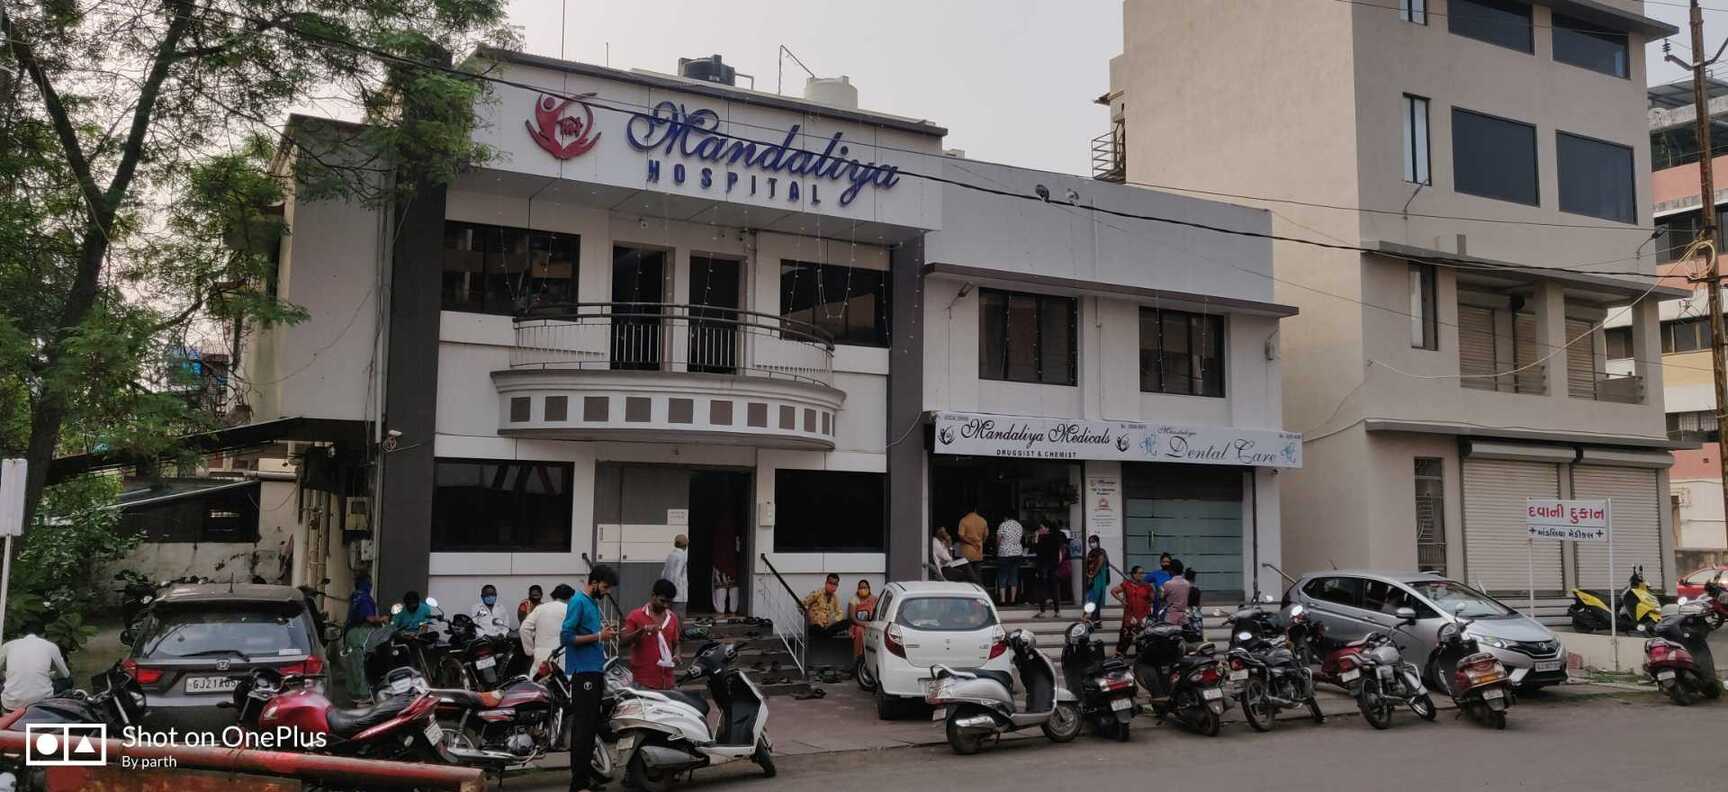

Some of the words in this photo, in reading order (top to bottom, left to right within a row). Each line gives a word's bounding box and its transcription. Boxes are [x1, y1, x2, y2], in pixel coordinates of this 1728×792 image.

[626, 100, 900, 207] Mandaliya
[648, 159, 821, 205] HOSPITAL
[961, 418, 1045, 449] Mandaliya
[1048, 423, 1110, 445] Medicals
[996, 449, 1034, 457] DRUGGIST
[1044, 450, 1077, 458] CHEMIST
[1165, 435, 1230, 460] Dental
[1234, 438, 1276, 464] Care
[1528, 503, 1564, 518] દવાની
[1570, 506, 1604, 525] દુકાન
